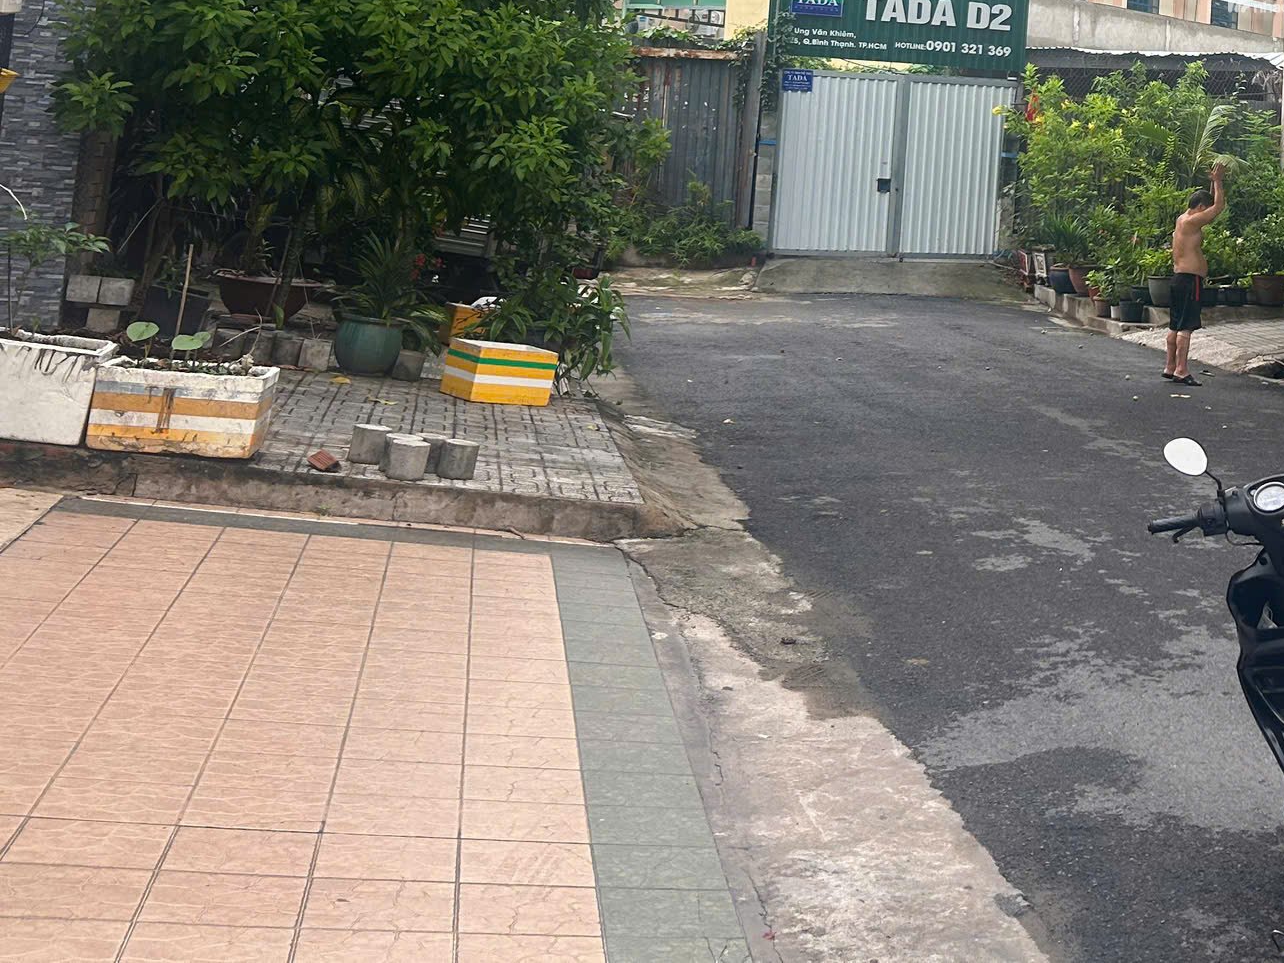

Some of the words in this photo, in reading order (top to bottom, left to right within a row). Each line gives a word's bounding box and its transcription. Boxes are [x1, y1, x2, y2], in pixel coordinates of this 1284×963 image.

[966, 1, 1013, 32] D2
[859, 41, 887, 50] TP.HCM
[926, 40, 956, 53] 0901
[961, 43, 983, 55] 321
[988, 46, 1012, 58] 369
